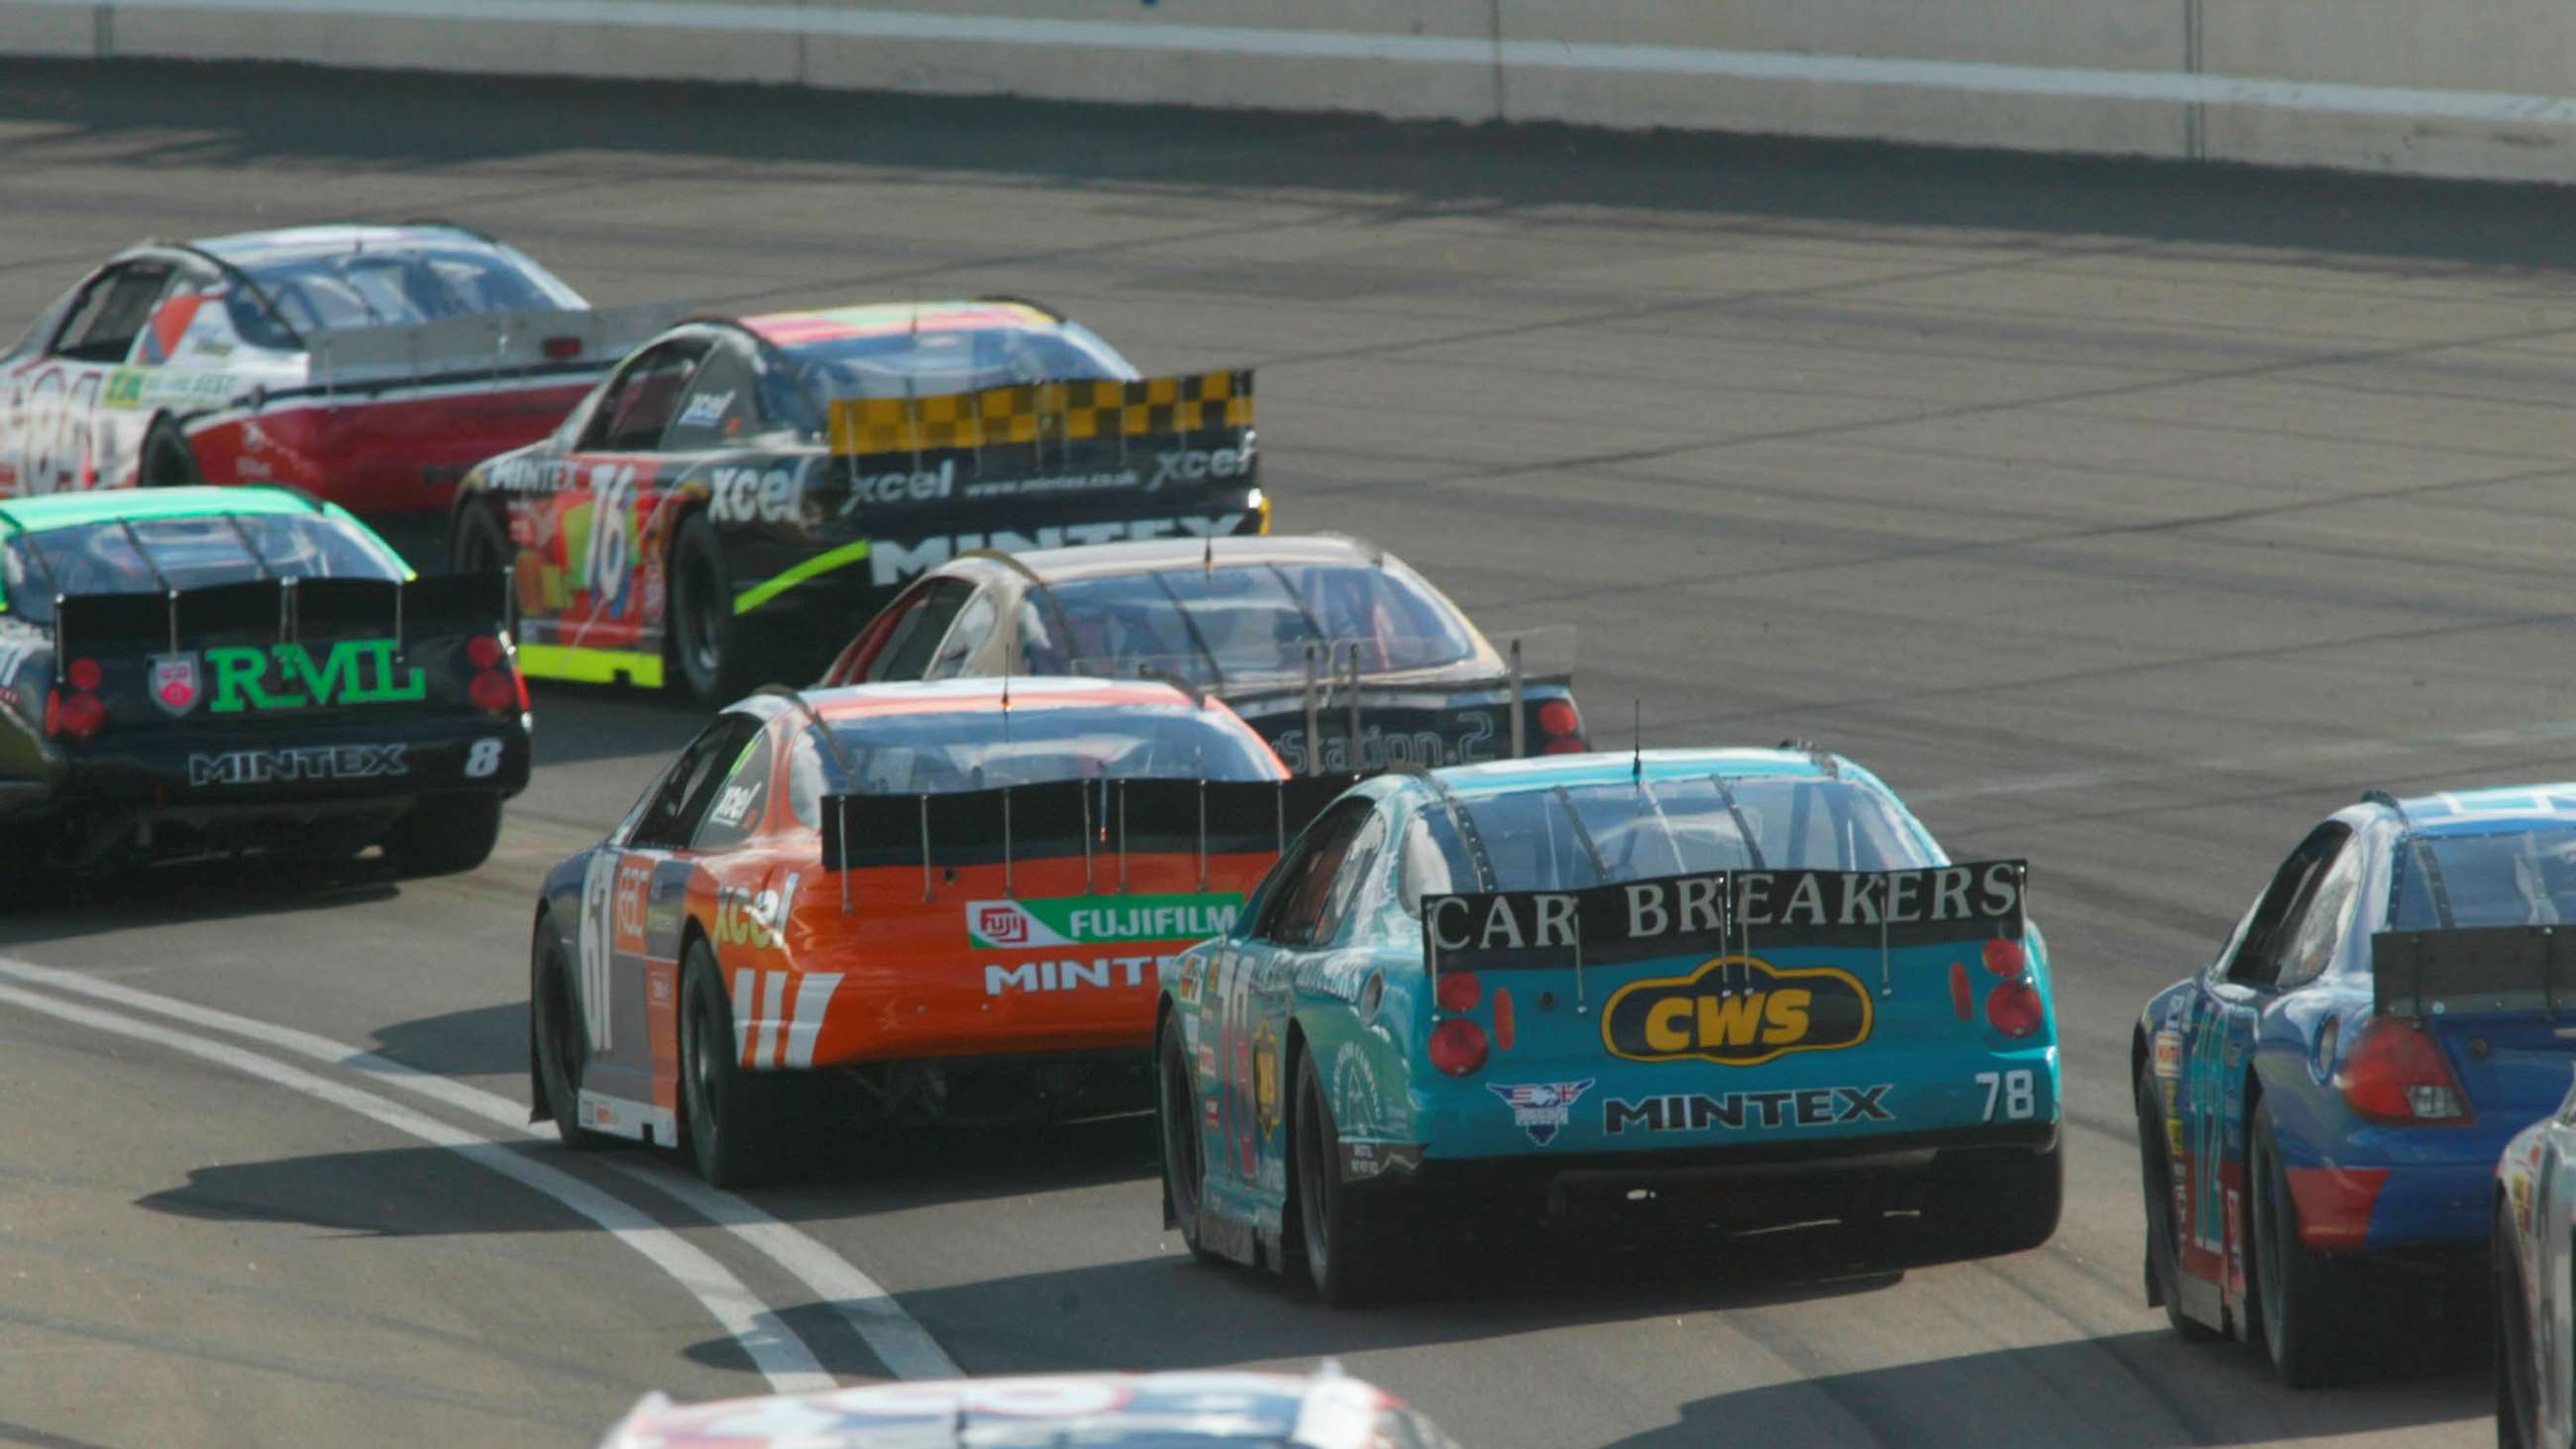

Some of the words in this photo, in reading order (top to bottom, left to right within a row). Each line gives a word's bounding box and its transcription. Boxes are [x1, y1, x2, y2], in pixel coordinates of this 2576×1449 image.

[707, 456, 813, 523] xcel
[841, 460, 954, 516] xcel
[584, 463, 636, 601] 76
[205, 638, 426, 712] RML
[189, 743, 409, 785] MINTEX
[464, 737, 502, 777] 8
[1070, 904, 1238, 938] FUJIFILM
[1430, 894, 1579, 951] CAR
[1628, 862, 2018, 938] BREAKERS
[1645, 988, 1813, 1053] CWS
[1602, 1084, 1897, 1135] MINTEX
[1975, 1070, 2036, 1122] 78
